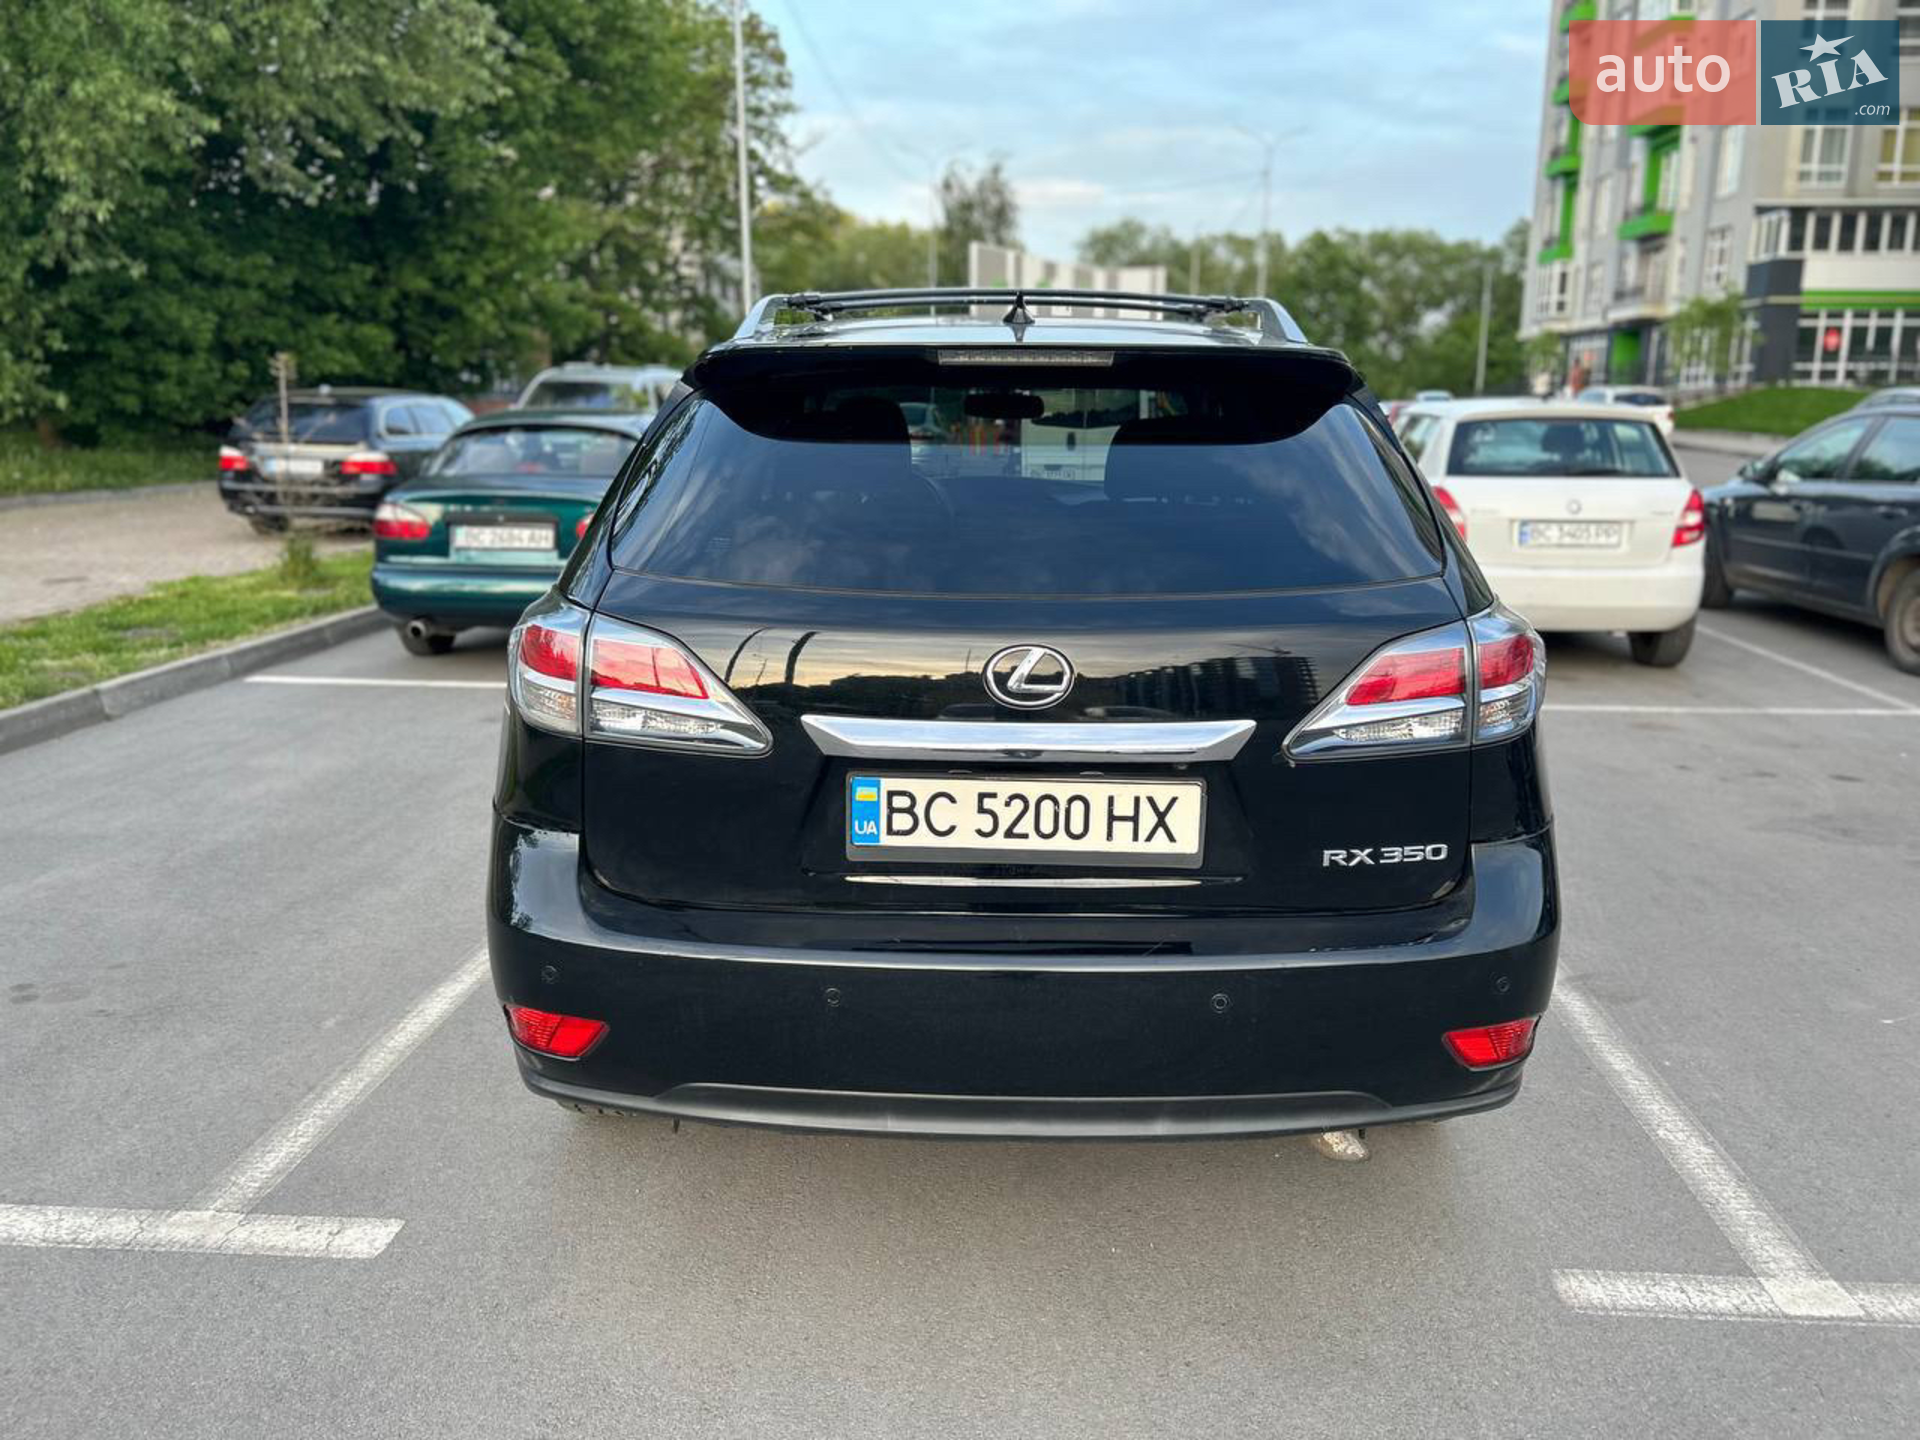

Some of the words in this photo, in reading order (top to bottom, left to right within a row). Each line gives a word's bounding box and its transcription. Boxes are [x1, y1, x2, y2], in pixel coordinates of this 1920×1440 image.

[855, 821, 878, 835] UA
[886, 790, 957, 838] BC
[975, 792, 1090, 840] 5200
[1107, 795, 1178, 843] HX
[1322, 848, 1375, 867] RX
[1379, 843, 1449, 863] 350
